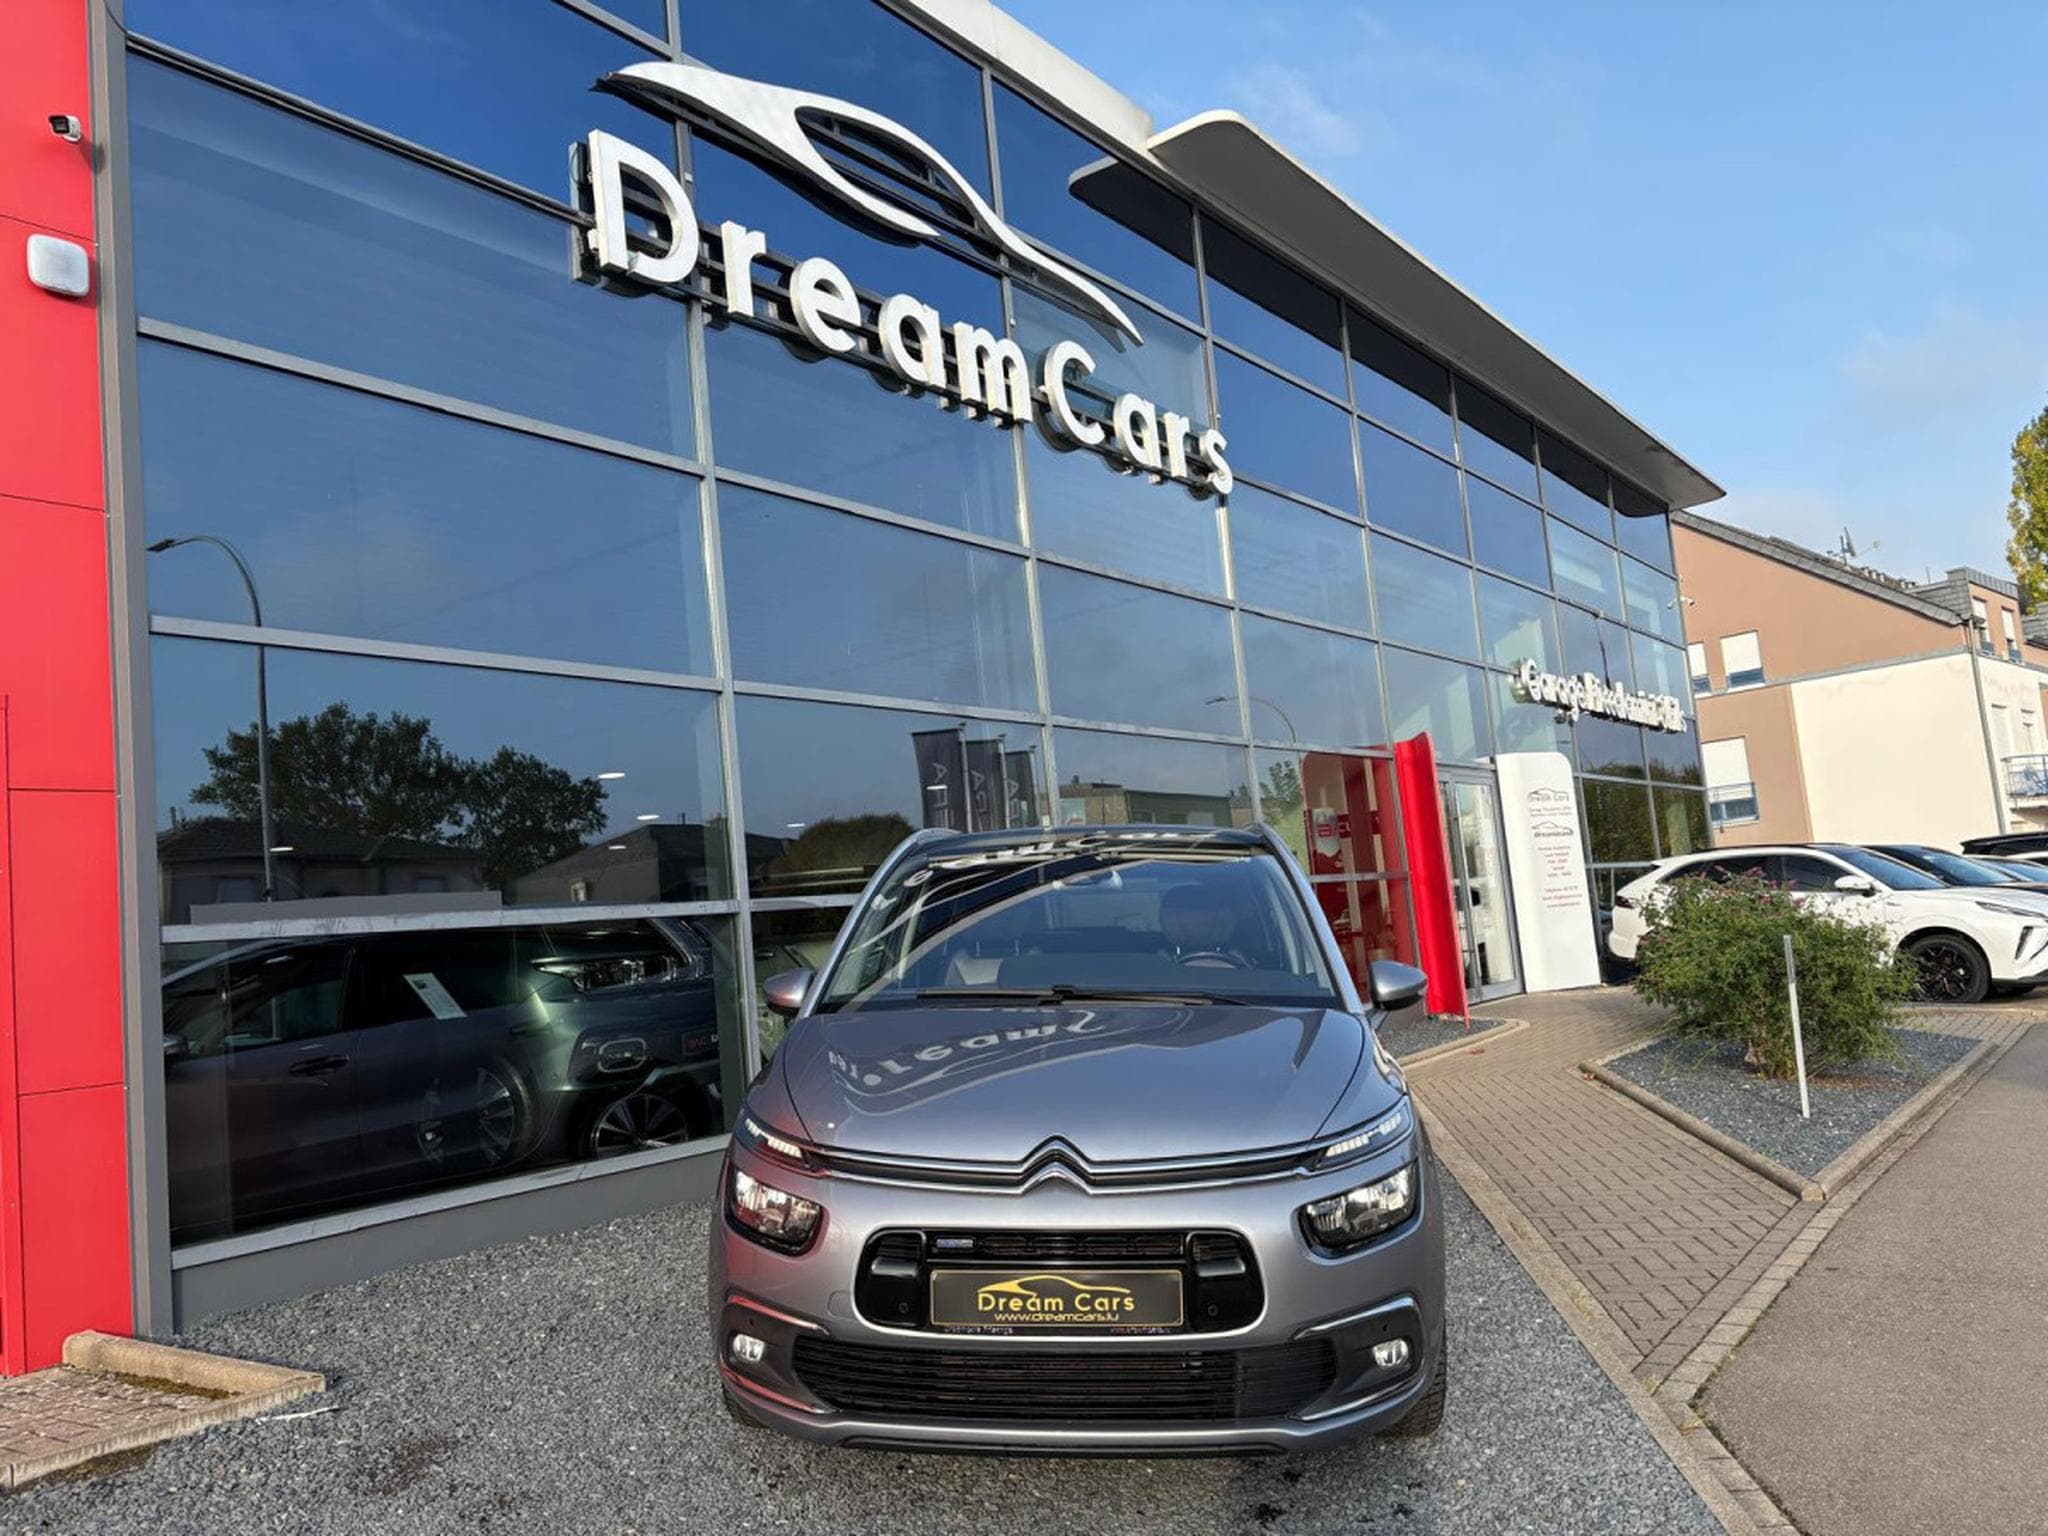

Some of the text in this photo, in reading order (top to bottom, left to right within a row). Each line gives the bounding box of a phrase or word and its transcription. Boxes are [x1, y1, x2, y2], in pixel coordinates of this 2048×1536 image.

[586, 128, 1234, 495] Dream Cars
[977, 1293, 1136, 1312] Dream Cars
[994, 1311, 1120, 1323] www.dreamcars.lu
